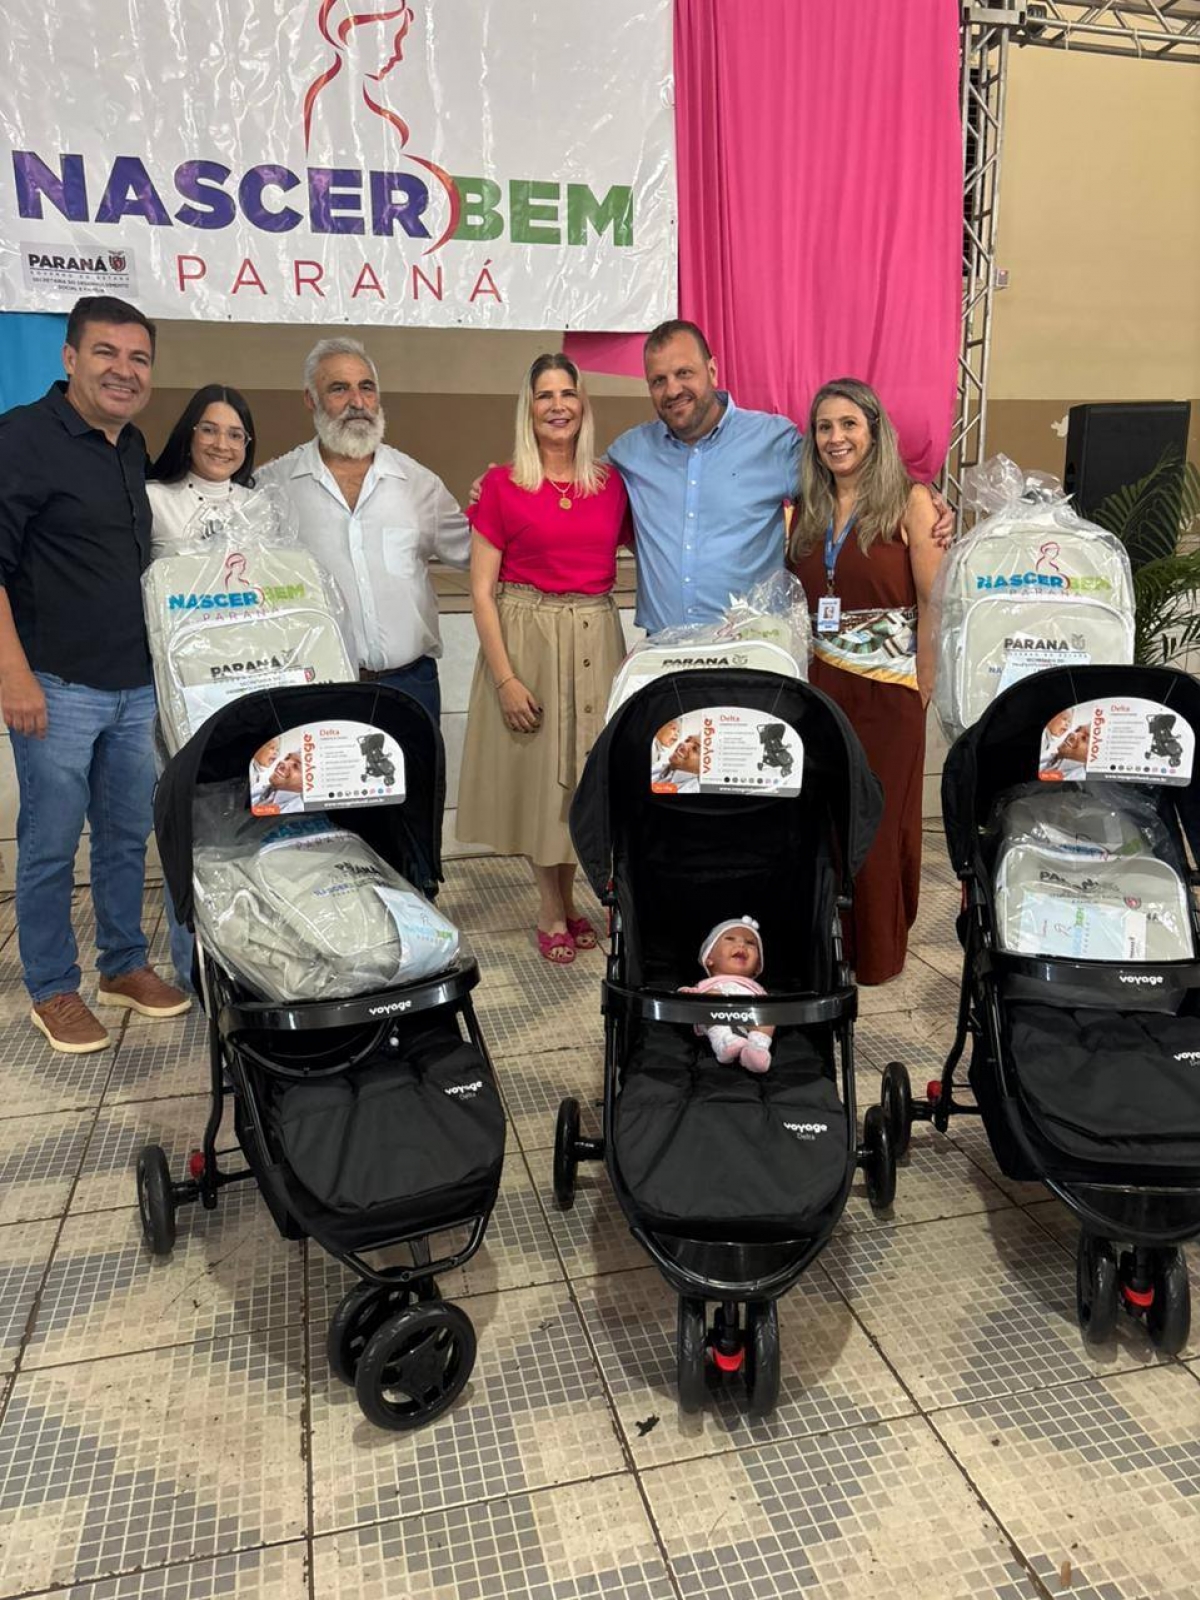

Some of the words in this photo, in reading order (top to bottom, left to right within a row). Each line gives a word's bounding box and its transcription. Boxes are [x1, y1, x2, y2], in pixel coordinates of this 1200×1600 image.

[12, 151, 432, 239] NASCER
[452, 175, 634, 246] BEM
[28, 253, 107, 272] PARANÁ
[178, 253, 502, 304] PARANÁ
[977, 572, 1064, 589] NASCER
[168, 591, 261, 610] NASCER
[1090, 708, 1106, 763] voyage
[701, 718, 715, 774] voyage
[303, 733, 317, 792] voyage
[1119, 975, 1164, 986] voyage
[368, 1000, 412, 1015] voyage
[710, 1011, 756, 1022] voyage
[444, 1081, 483, 1095] voyage
[783, 1122, 828, 1133] voyage
